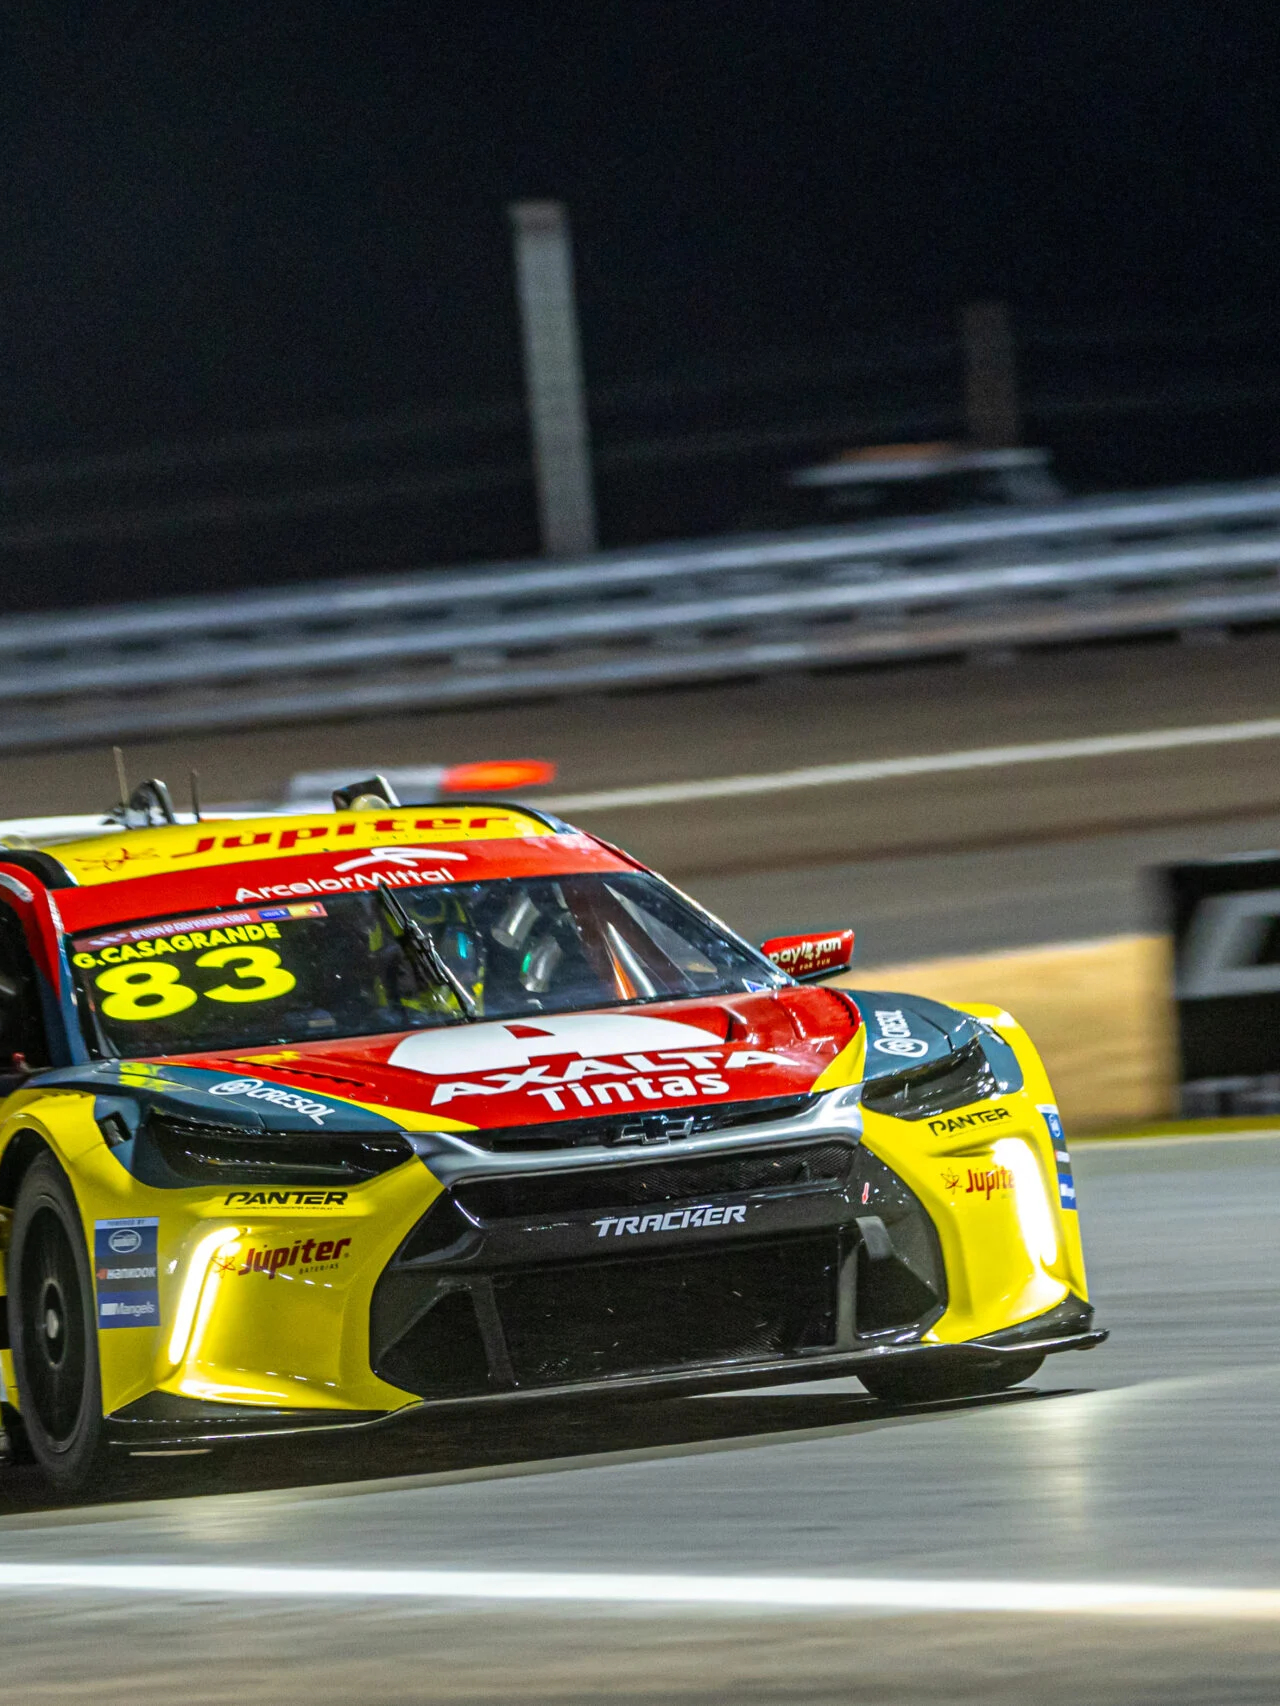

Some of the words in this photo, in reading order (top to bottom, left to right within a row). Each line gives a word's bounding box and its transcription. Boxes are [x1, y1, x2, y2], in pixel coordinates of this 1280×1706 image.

[236, 868, 455, 903] ArcelorMittal
[95, 946, 297, 1021] 83
[430, 1050, 801, 1106] AXALTA
[527, 1071, 730, 1112] Tintas
[246, 1088, 336, 1126] CRESOL
[928, 1107, 1012, 1137] PANTER
[224, 1191, 348, 1206] PANTER
[592, 1205, 748, 1238] TRACKER
